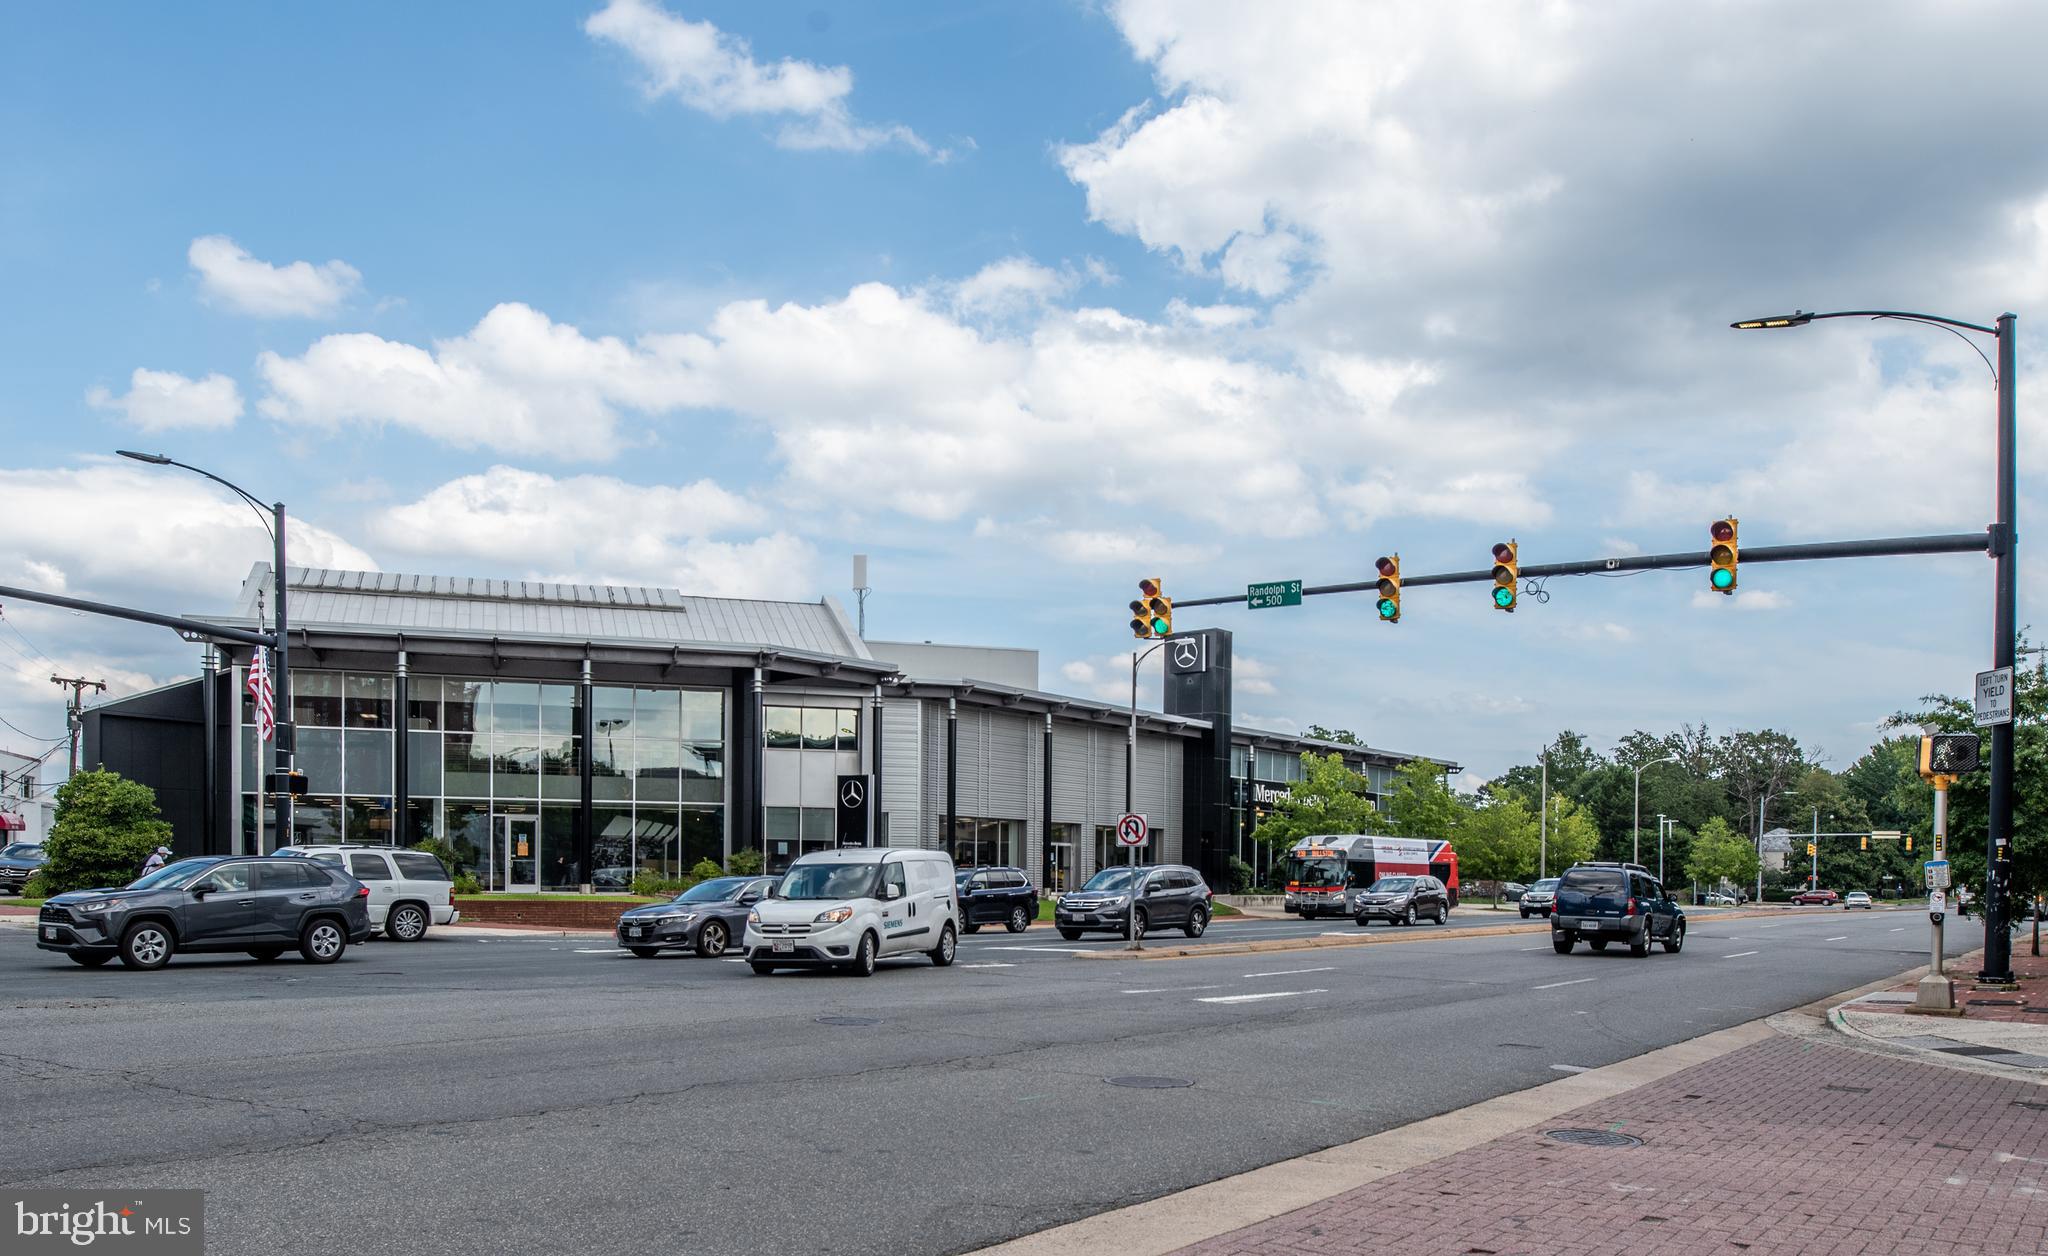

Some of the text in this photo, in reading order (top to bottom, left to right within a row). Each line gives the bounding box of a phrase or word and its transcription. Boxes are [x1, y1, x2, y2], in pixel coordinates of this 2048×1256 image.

[1250, 582, 1300, 597] Randolph St
[1266, 595, 1282, 606] 500
[1980, 673, 2008, 687] LEFT TURN
[1983, 685, 2005, 698] YIELD
[1990, 699, 1997, 708] TO
[1977, 708, 2010, 721] PEDESTRIANS
[883, 920, 903, 929] SIEMENS
